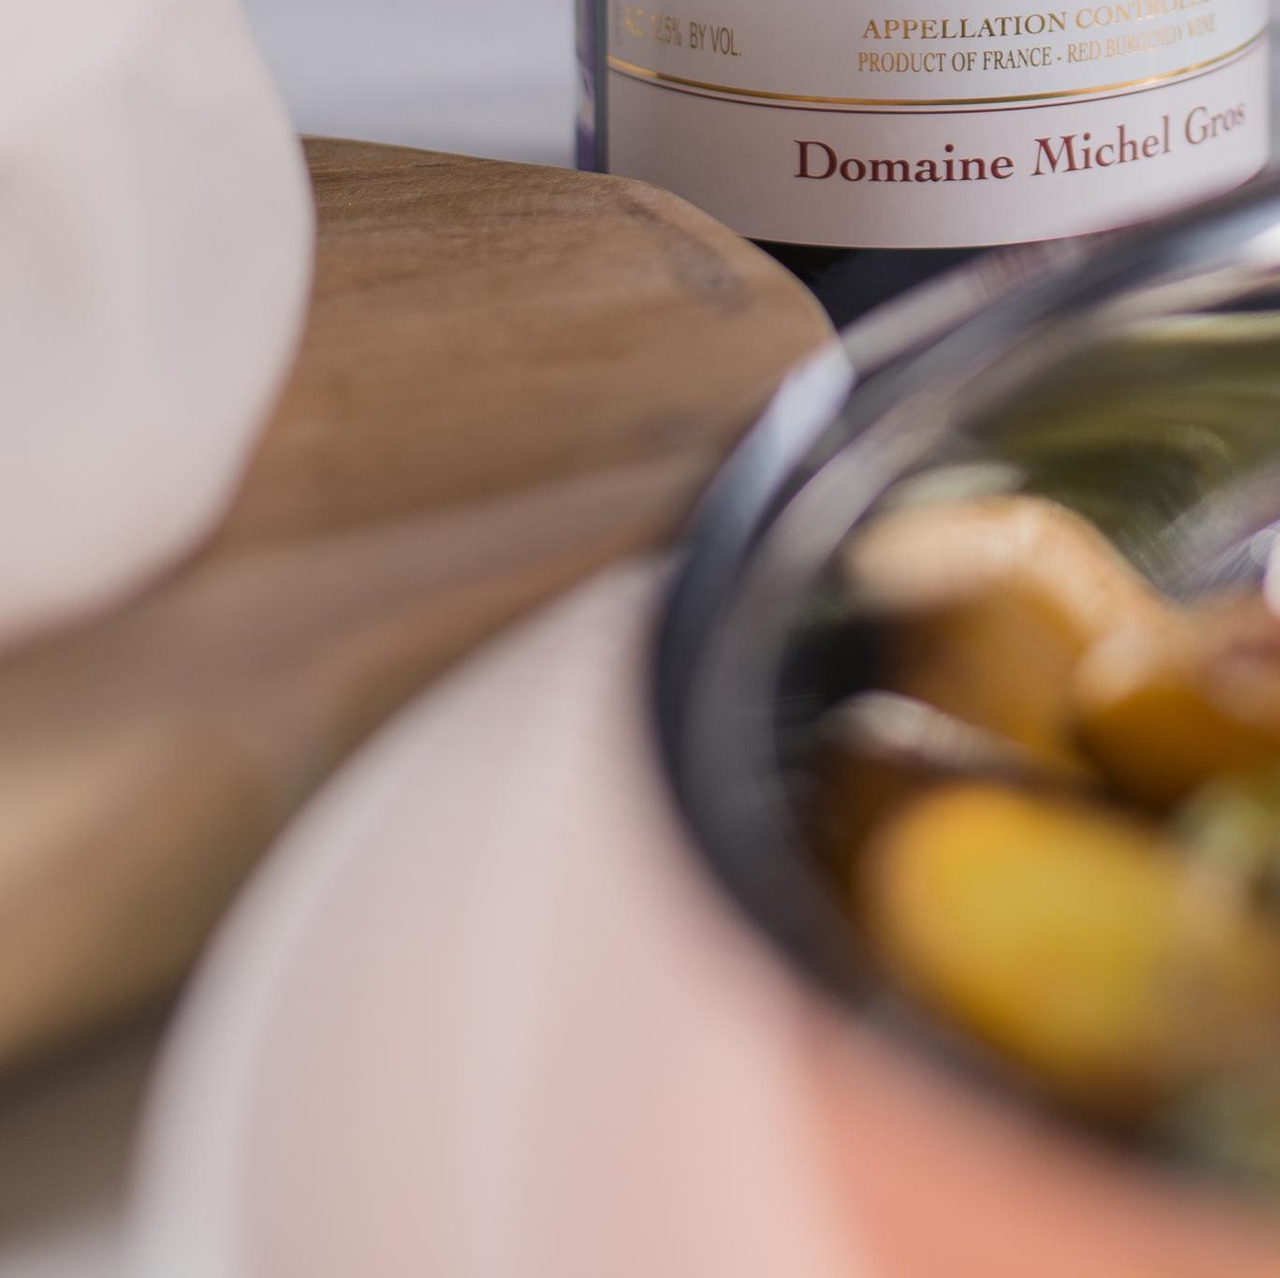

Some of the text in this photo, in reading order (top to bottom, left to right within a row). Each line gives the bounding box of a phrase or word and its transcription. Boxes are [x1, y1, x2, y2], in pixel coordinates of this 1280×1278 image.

[689, 21, 707, 49] BY
[710, 25, 742, 57] VOL.
[861, 11, 1068, 40] APPELLATION
[857, 51, 947, 73] PRODUCT
[951, 51, 977, 72] OF
[982, 46, 1053, 71] FRANCE
[1067, 39, 1101, 63] RED
[793, 103, 1247, 183] Domaine Michel Gros
